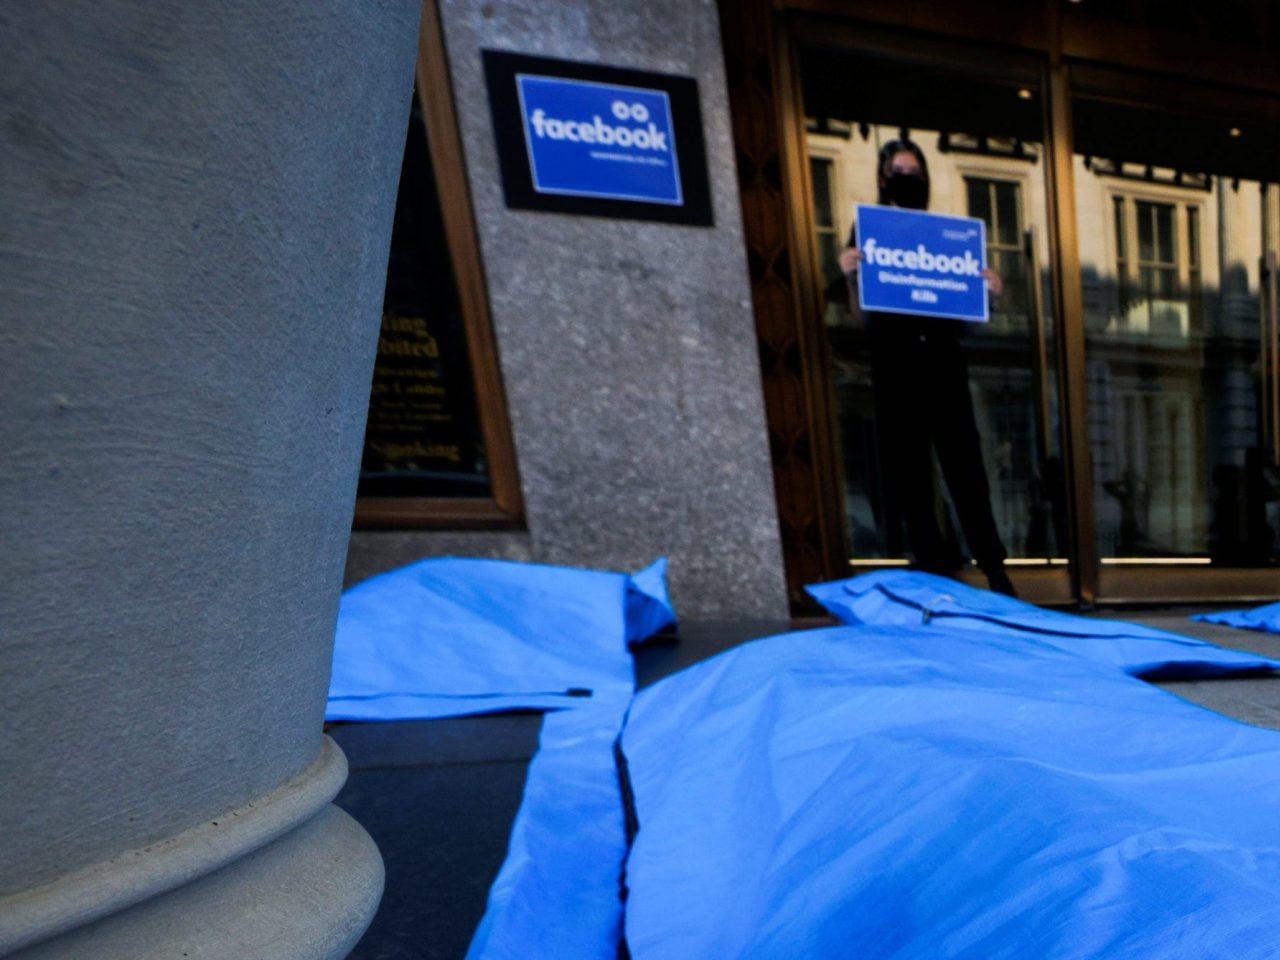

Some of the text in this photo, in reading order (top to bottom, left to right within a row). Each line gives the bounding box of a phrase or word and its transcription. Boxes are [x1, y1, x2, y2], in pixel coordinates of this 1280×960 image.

[531, 109, 668, 151] facebook
[864, 238, 980, 277] facebook
[878, 271, 969, 291] Disinformation
